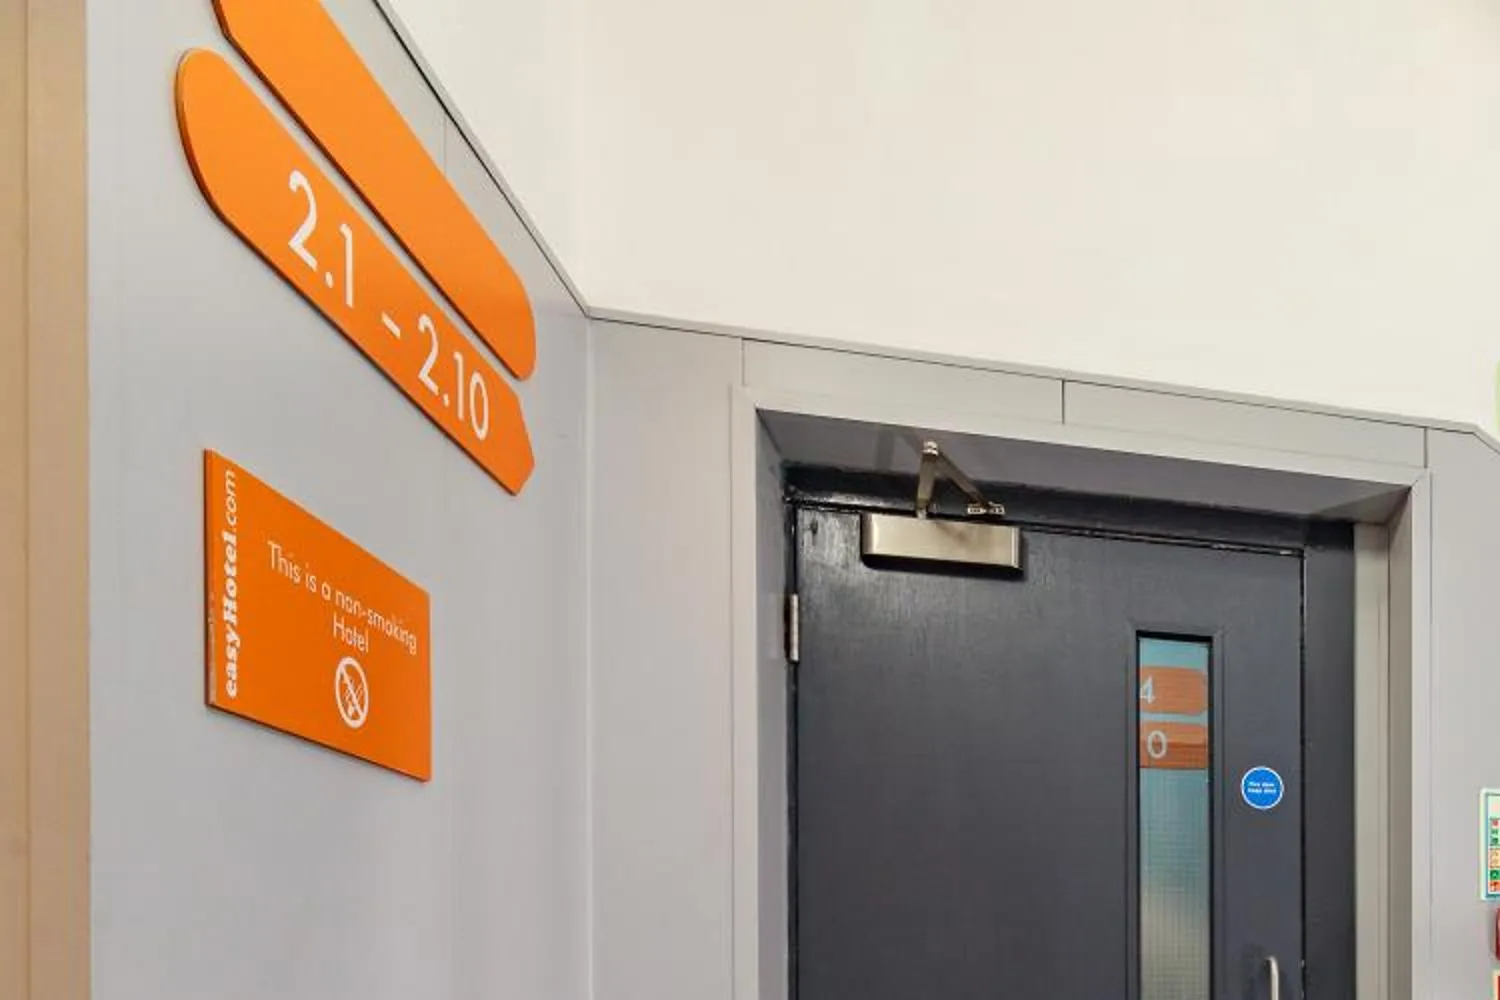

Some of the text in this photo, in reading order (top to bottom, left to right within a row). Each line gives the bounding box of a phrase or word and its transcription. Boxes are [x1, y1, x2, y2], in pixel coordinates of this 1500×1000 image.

[288, 169, 354, 308] 2.1
[417, 313, 490, 441] 2.10
[222, 470, 241, 698] easyHotel.com
[267, 540, 418, 655] This is a non-smoking
[332, 615, 370, 653] Hotel
